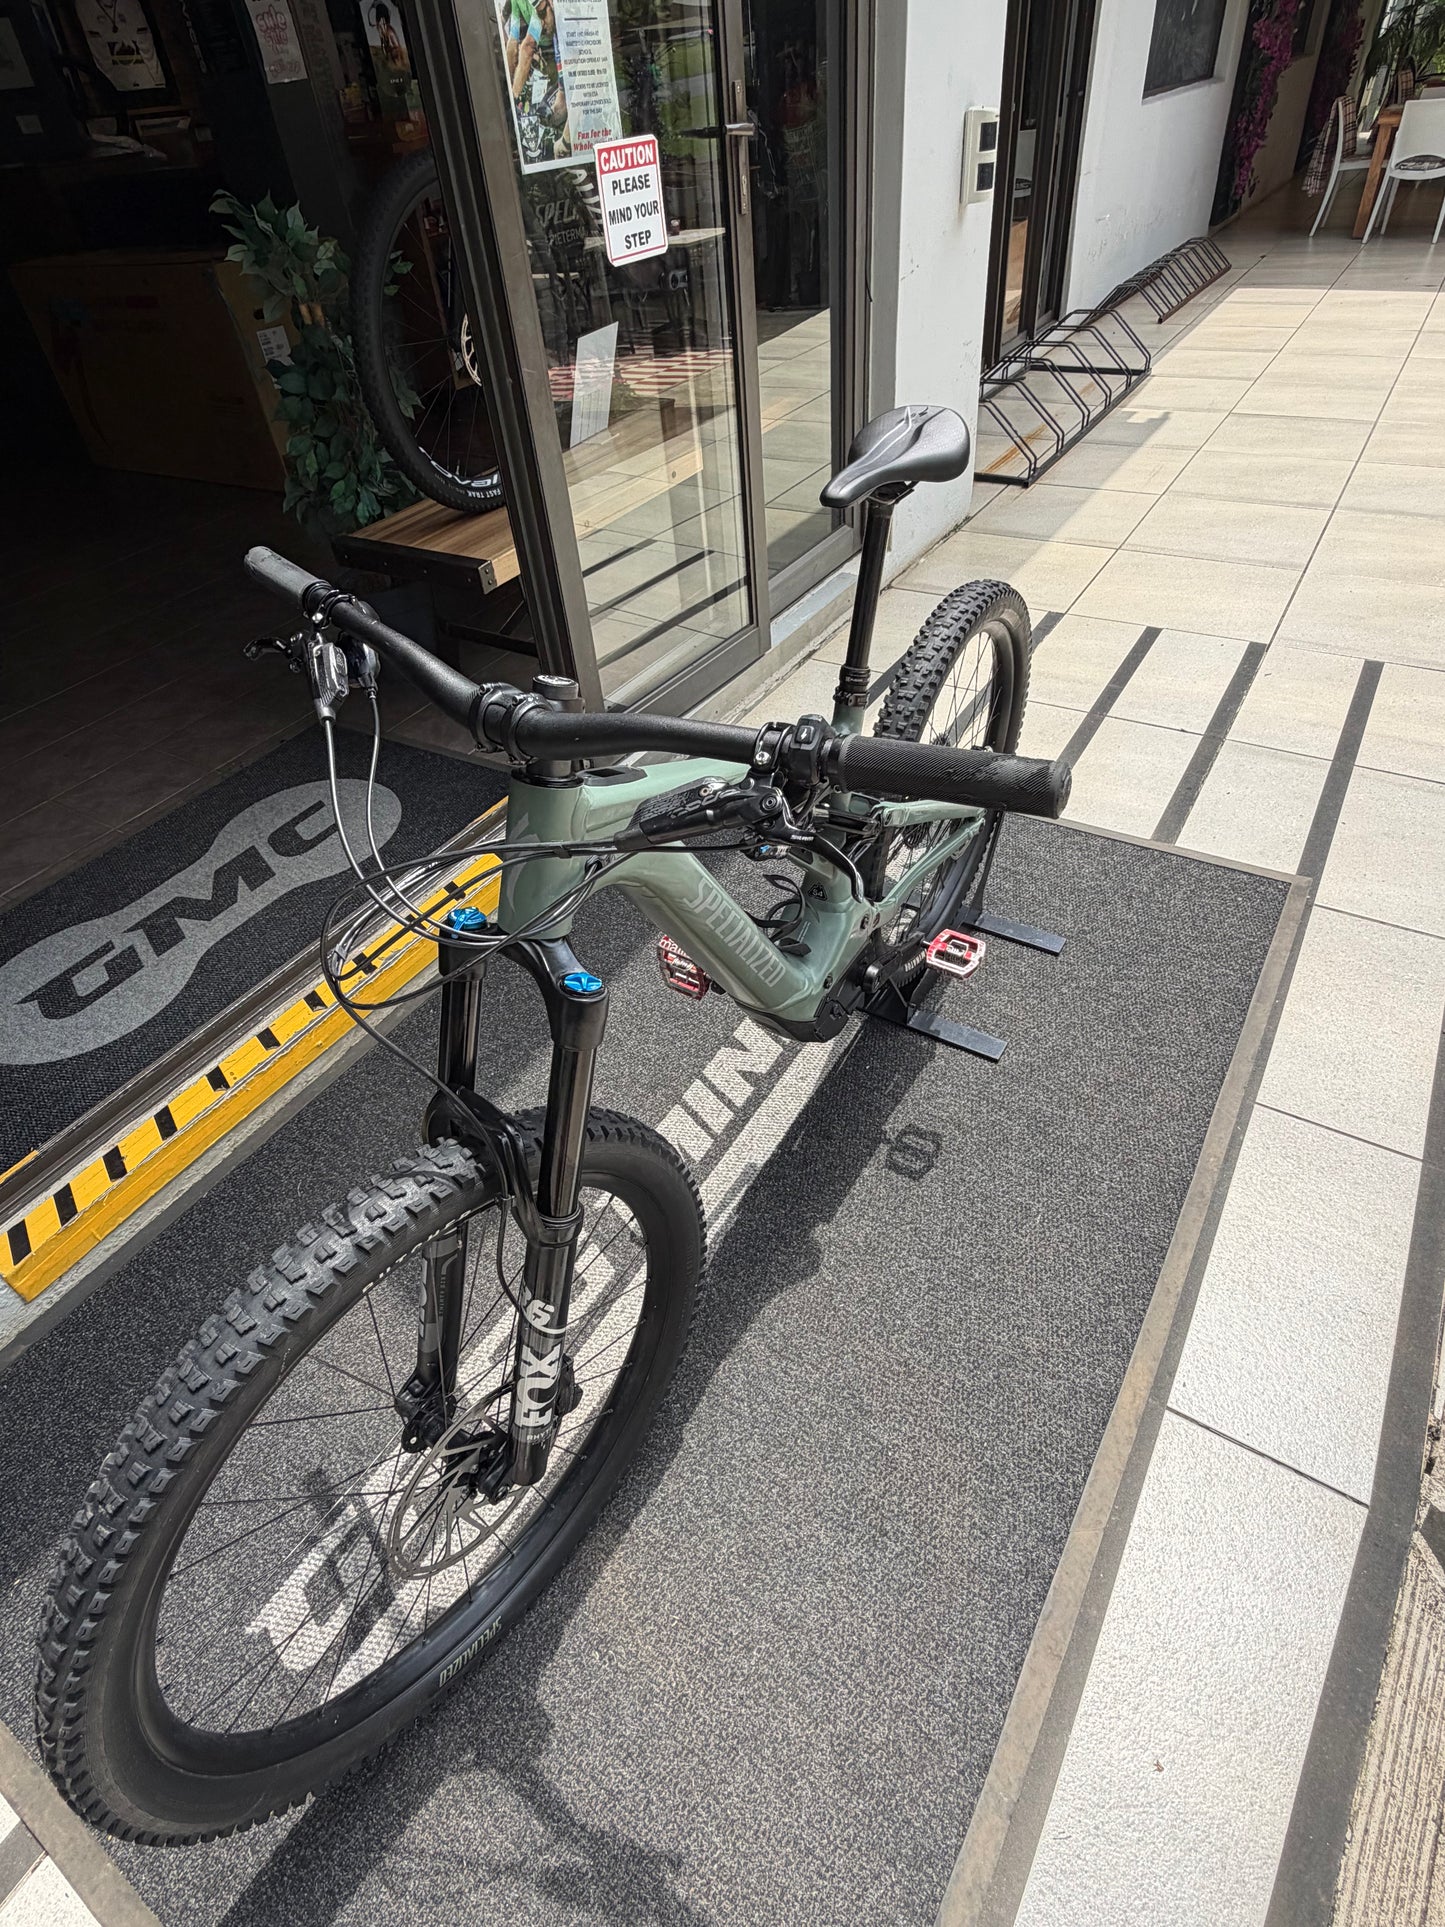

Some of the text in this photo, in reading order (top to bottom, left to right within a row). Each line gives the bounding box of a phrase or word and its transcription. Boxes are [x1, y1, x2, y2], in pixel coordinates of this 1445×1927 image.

[590, 128, 601, 138] for
[600, 143, 654, 172] CAUTION
[611, 173, 651, 196] PLEASE
[608, 199, 660, 226] MIND YOUR
[624, 229, 652, 250] STEP
[13, 799, 341, 1020] GMC
[683, 877, 786, 988] SPECIALIZED
[513, 1343, 563, 1429] FOX
[439, 1615, 502, 1688] SPECIALIZED
